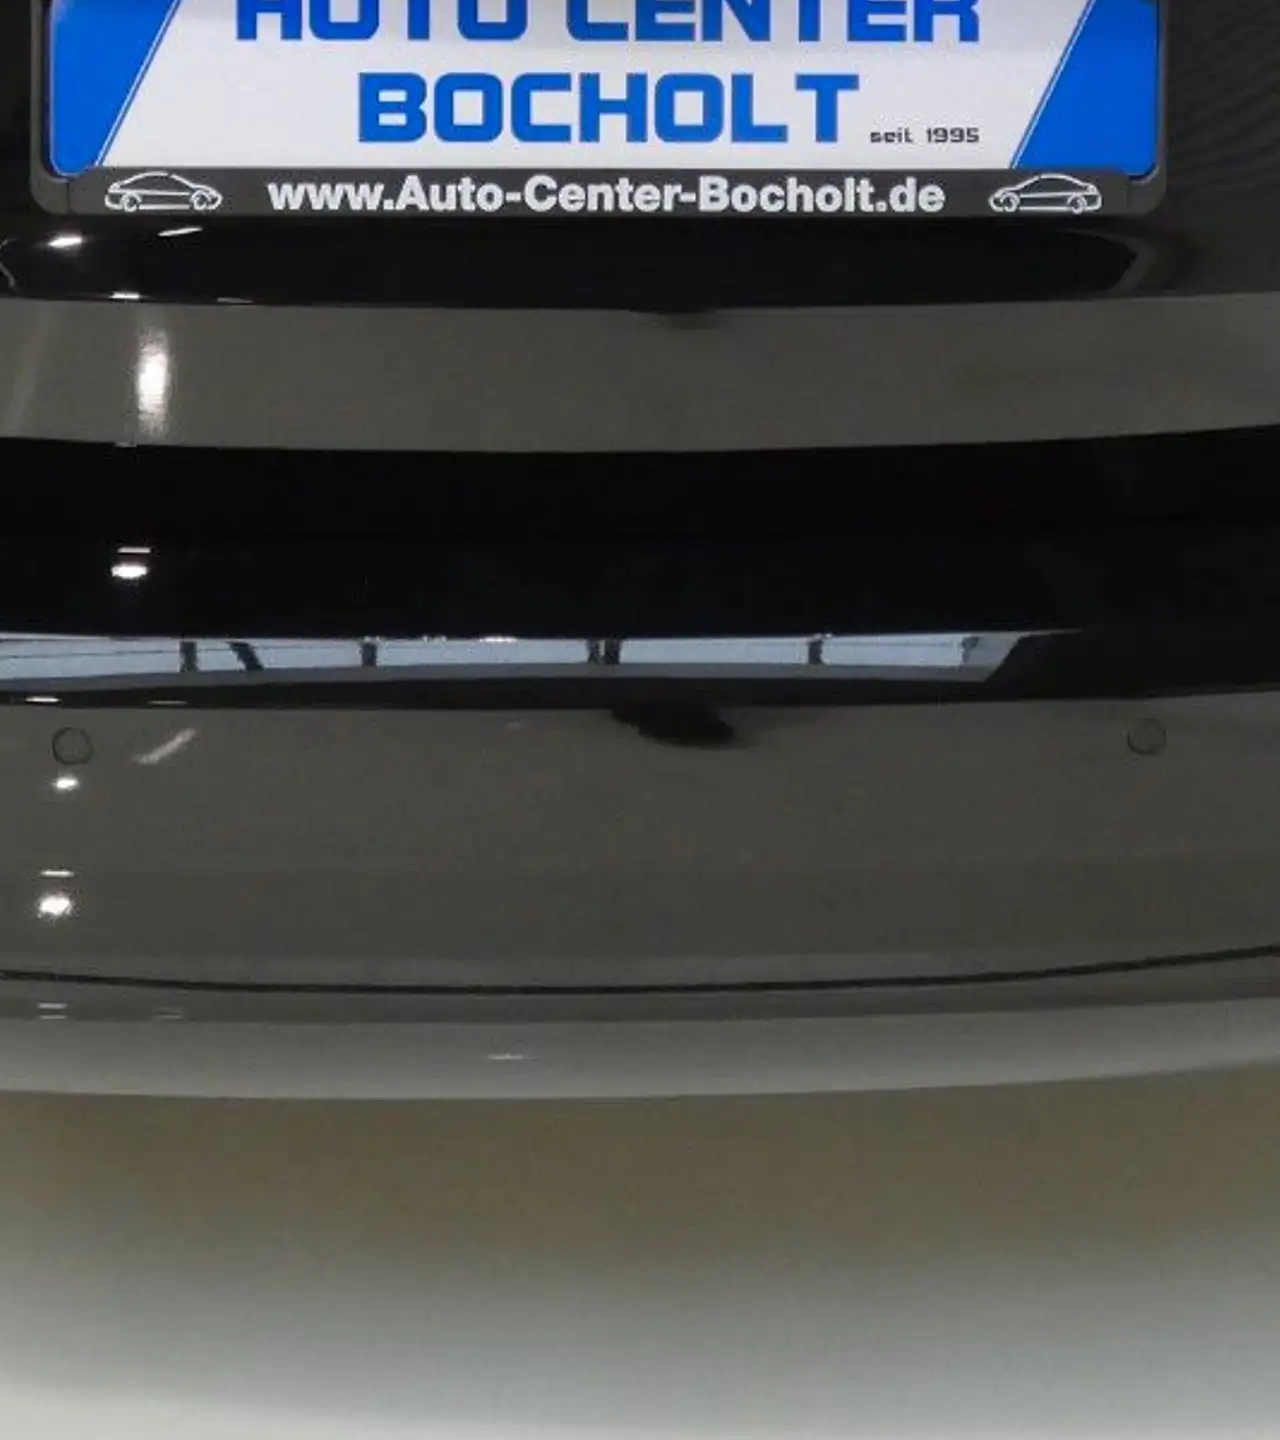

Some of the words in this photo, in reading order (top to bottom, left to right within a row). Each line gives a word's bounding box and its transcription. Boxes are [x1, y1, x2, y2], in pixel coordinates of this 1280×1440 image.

[358, 72, 860, 143] BOCHOLT
[869, 128, 913, 143] seit
[926, 127, 980, 143] 1995
[267, 174, 946, 214] www.Auto-Center-Bocholt.de
